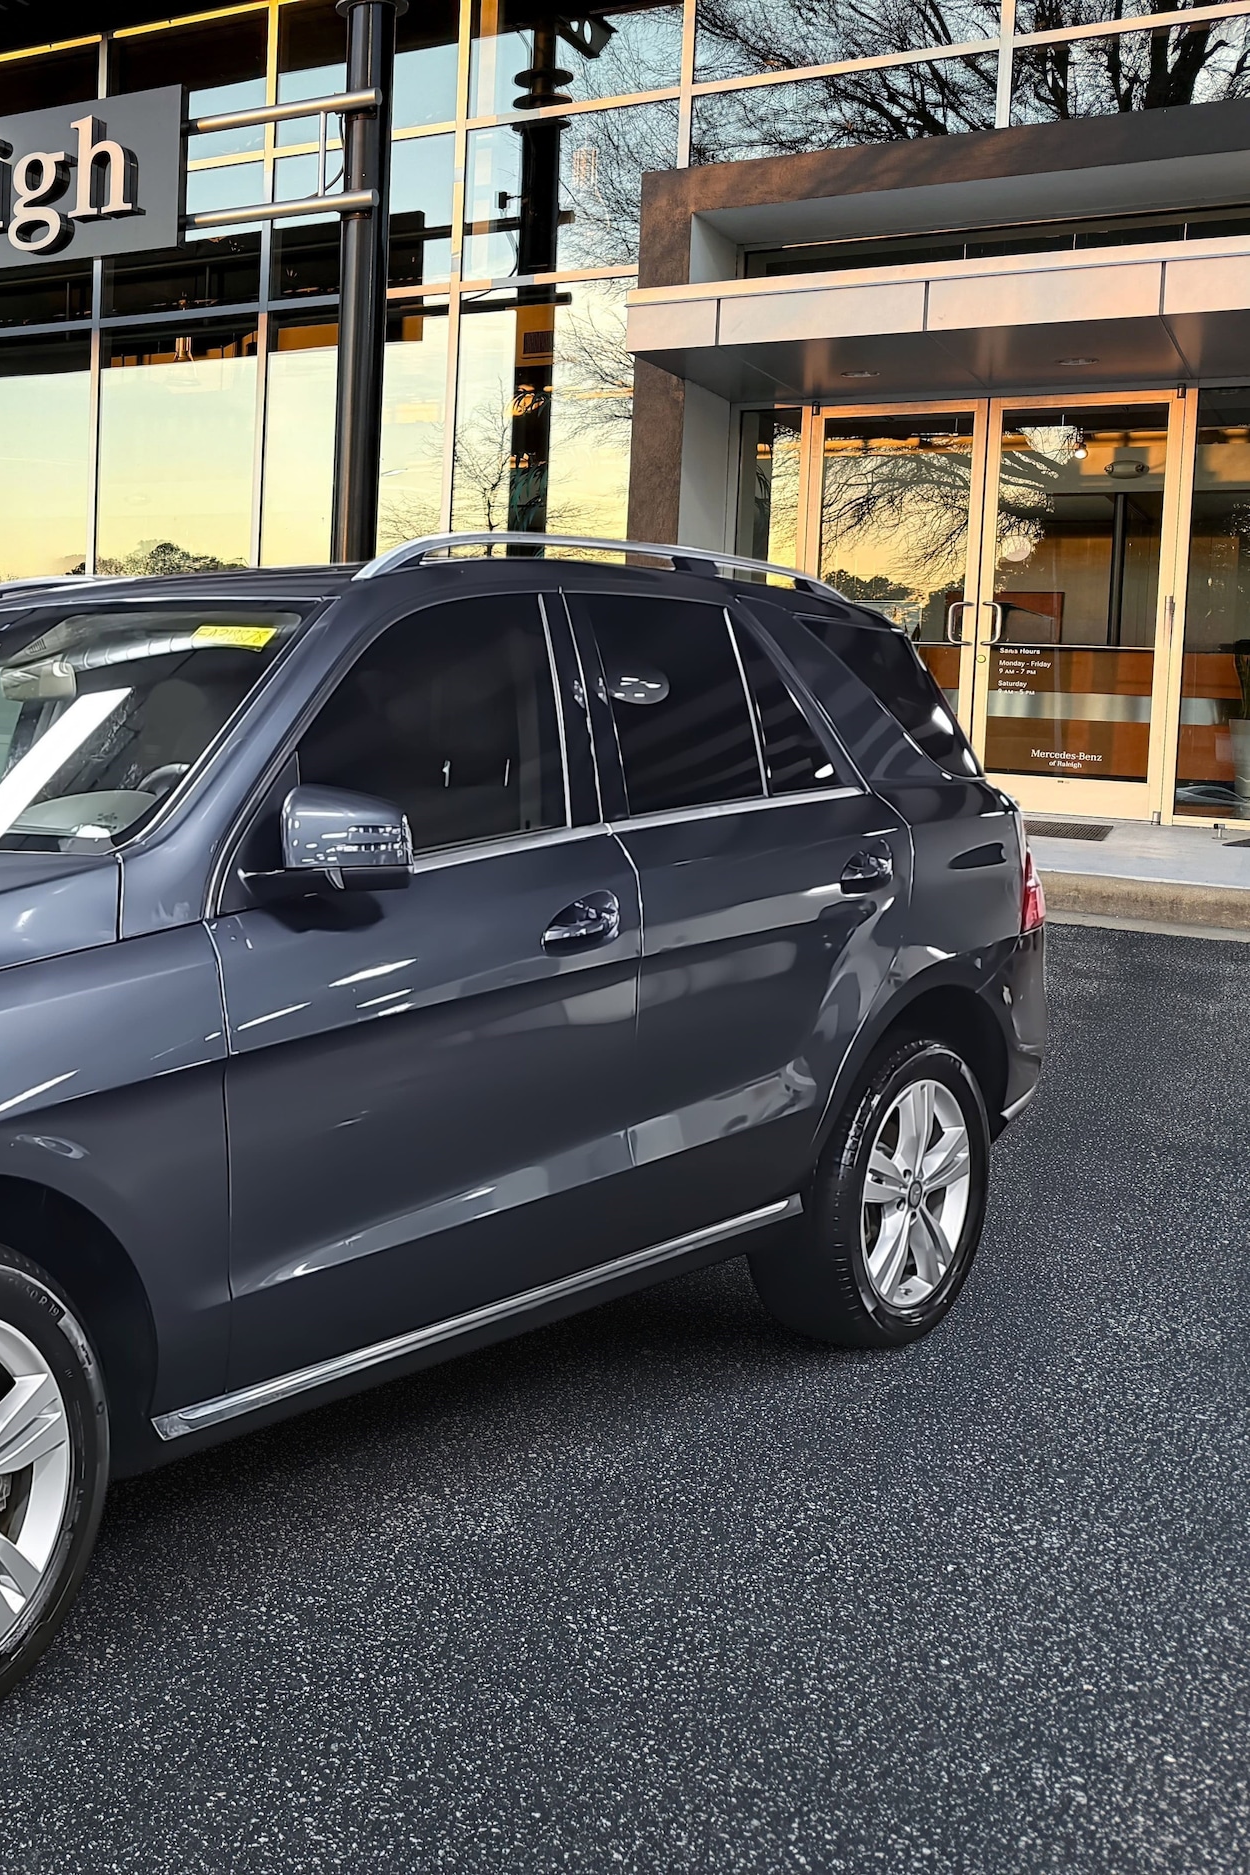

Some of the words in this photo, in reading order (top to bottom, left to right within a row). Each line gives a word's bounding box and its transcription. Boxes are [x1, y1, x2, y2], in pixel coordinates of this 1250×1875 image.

[998, 680, 1027, 688] Saturday
[1031, 749, 1103, 761] Mercedes-Benz
[1057, 761, 1082, 769] Raleigh
